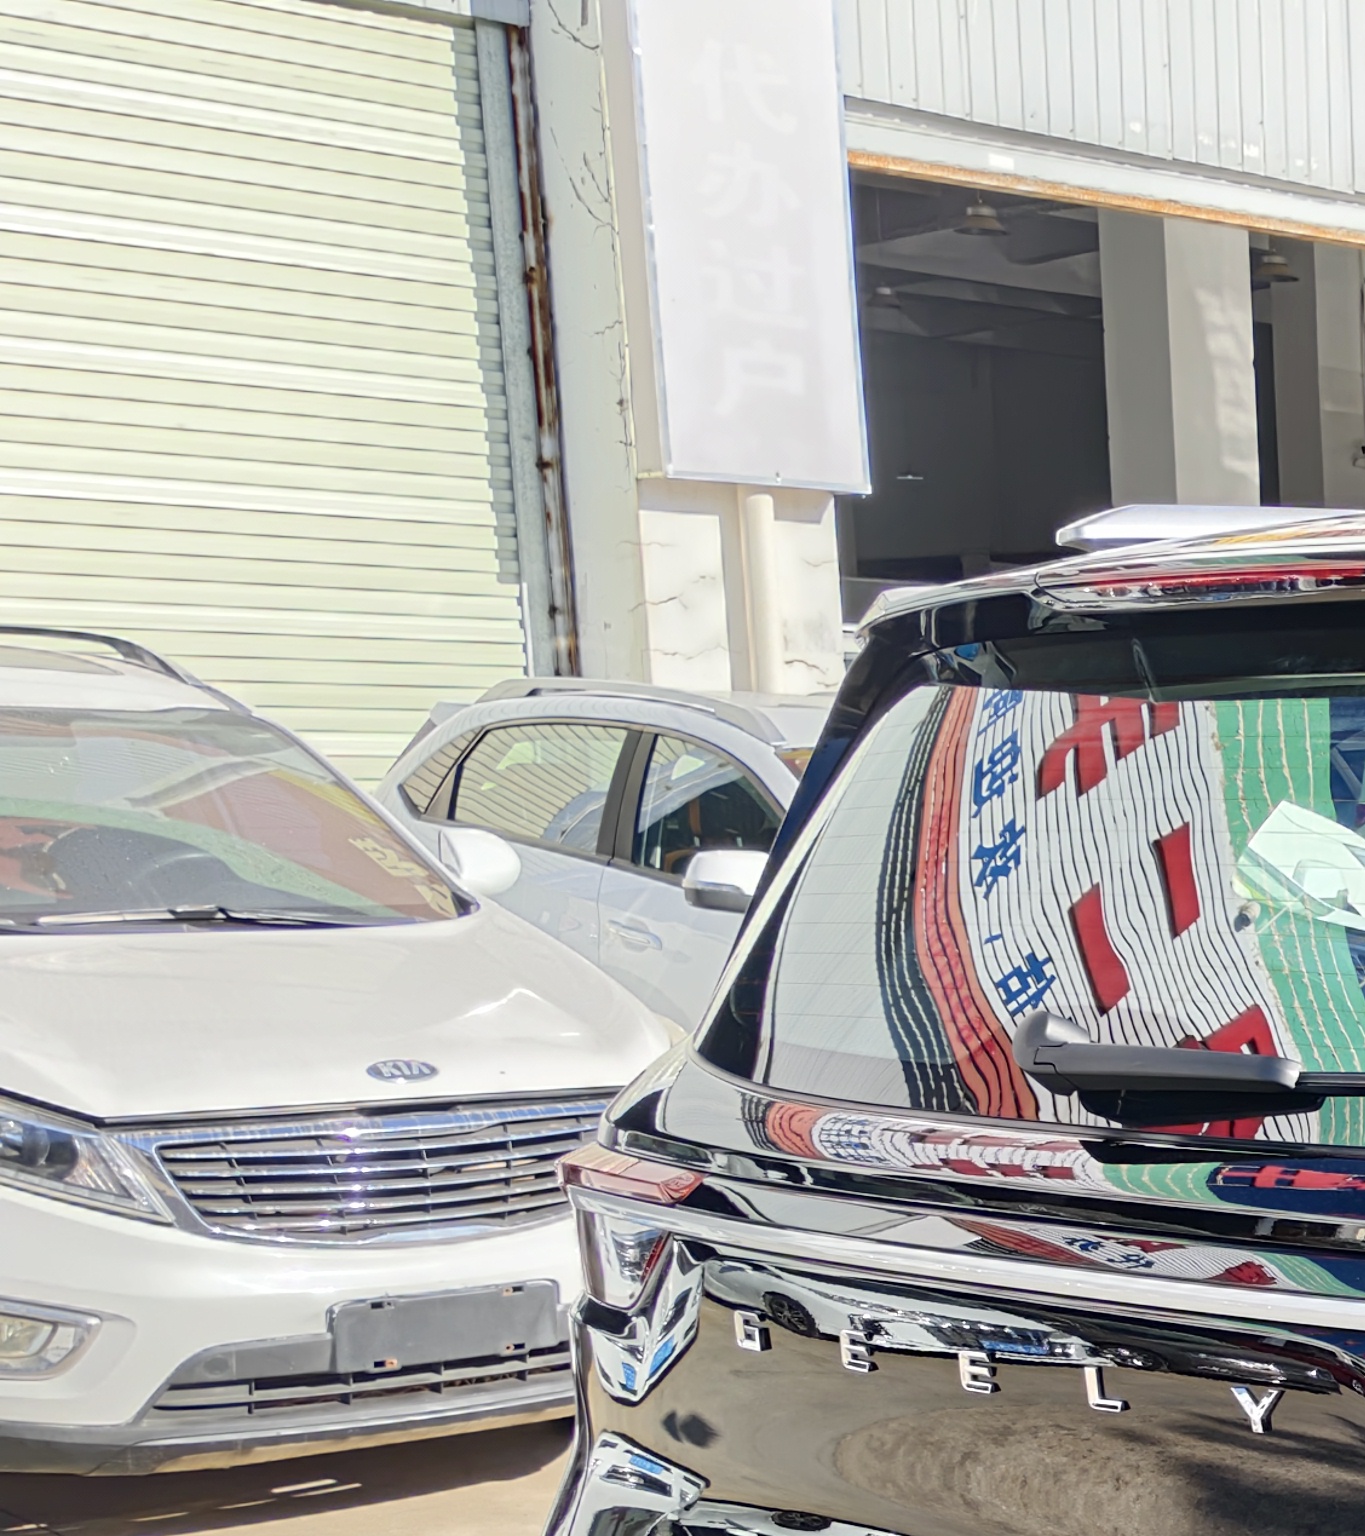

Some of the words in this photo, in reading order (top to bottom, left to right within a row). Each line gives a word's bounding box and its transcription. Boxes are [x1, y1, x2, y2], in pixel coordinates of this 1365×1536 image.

[687, 37, 809, 418] 代办过户
[376, 1060, 432, 1077] KIA
[733, 1309, 1287, 1434] GEELY
